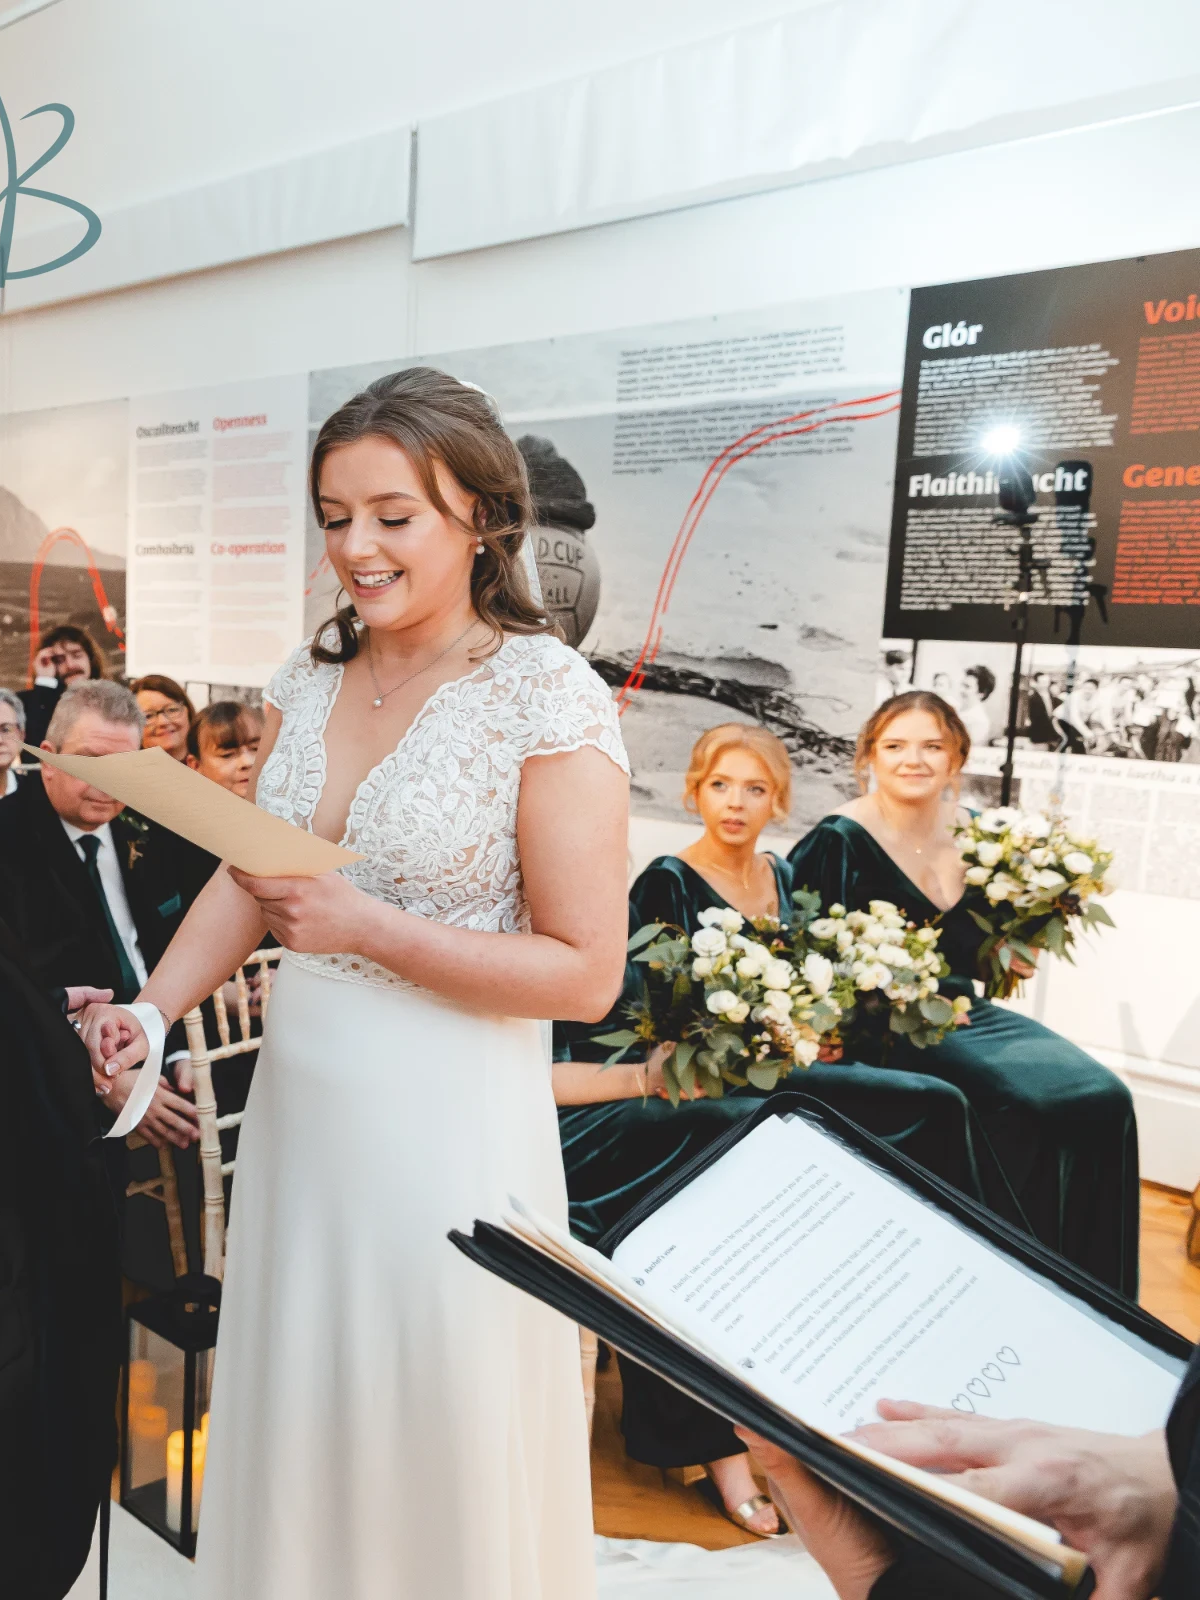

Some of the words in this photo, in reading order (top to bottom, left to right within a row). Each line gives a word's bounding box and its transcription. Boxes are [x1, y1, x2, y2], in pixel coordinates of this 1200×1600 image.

[1143, 293, 1200, 325] Voi
[922, 320, 983, 349] Glór
[212, 413, 267, 431] Openness
[211, 541, 286, 557] Co-operation
[644, 1255, 665, 1274] Rachel's
[663, 1244, 677, 1256] vows
